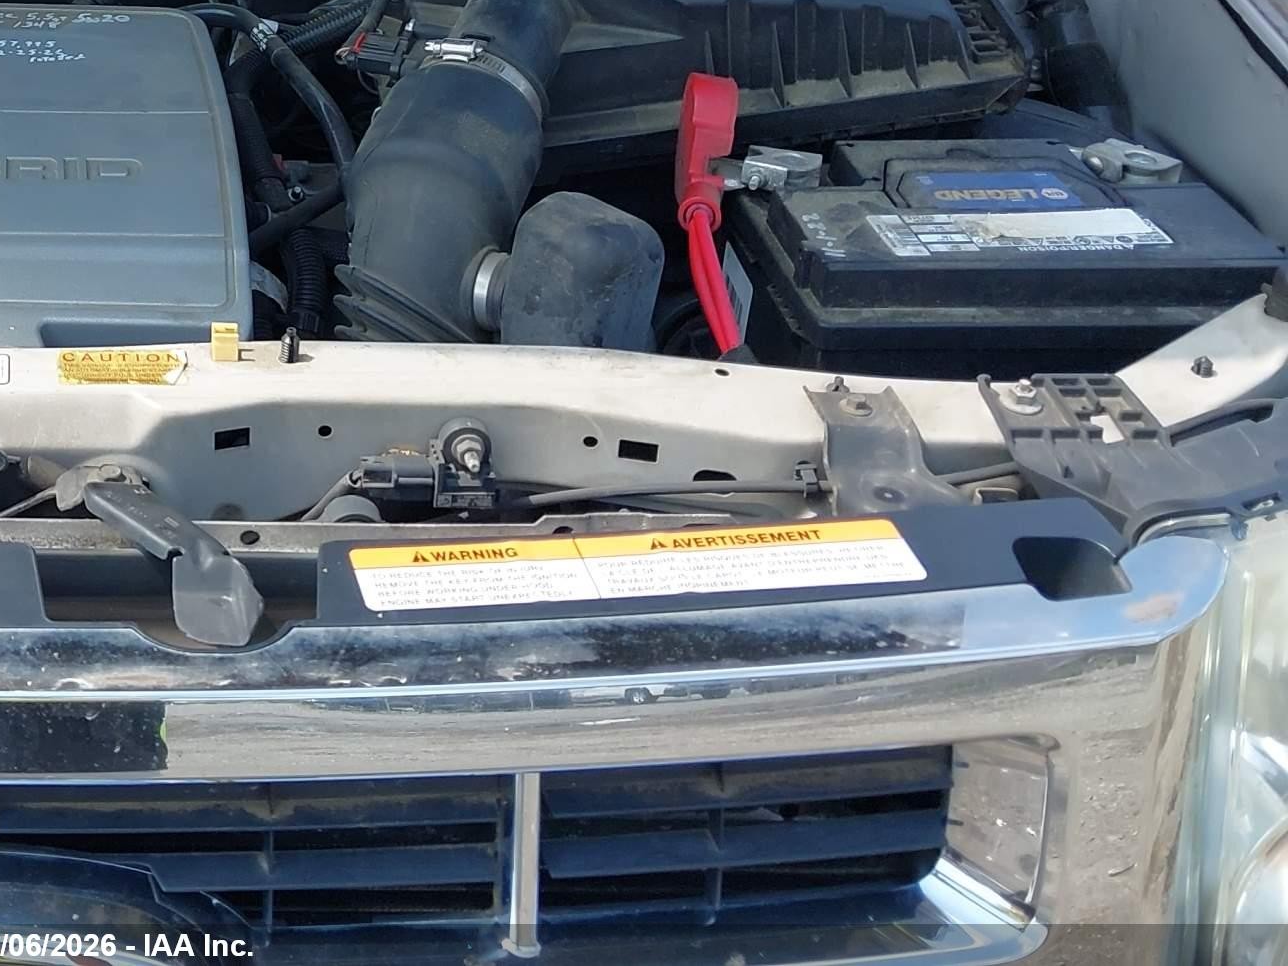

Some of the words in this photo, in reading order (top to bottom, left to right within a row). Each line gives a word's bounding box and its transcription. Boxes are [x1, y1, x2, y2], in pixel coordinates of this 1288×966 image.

[933, 188, 1039, 202] LEGEND
[62, 352, 181, 362] CAUTION
[672, 530, 821, 548] AVERTISSEMENT
[430, 547, 519, 562] WARNING
